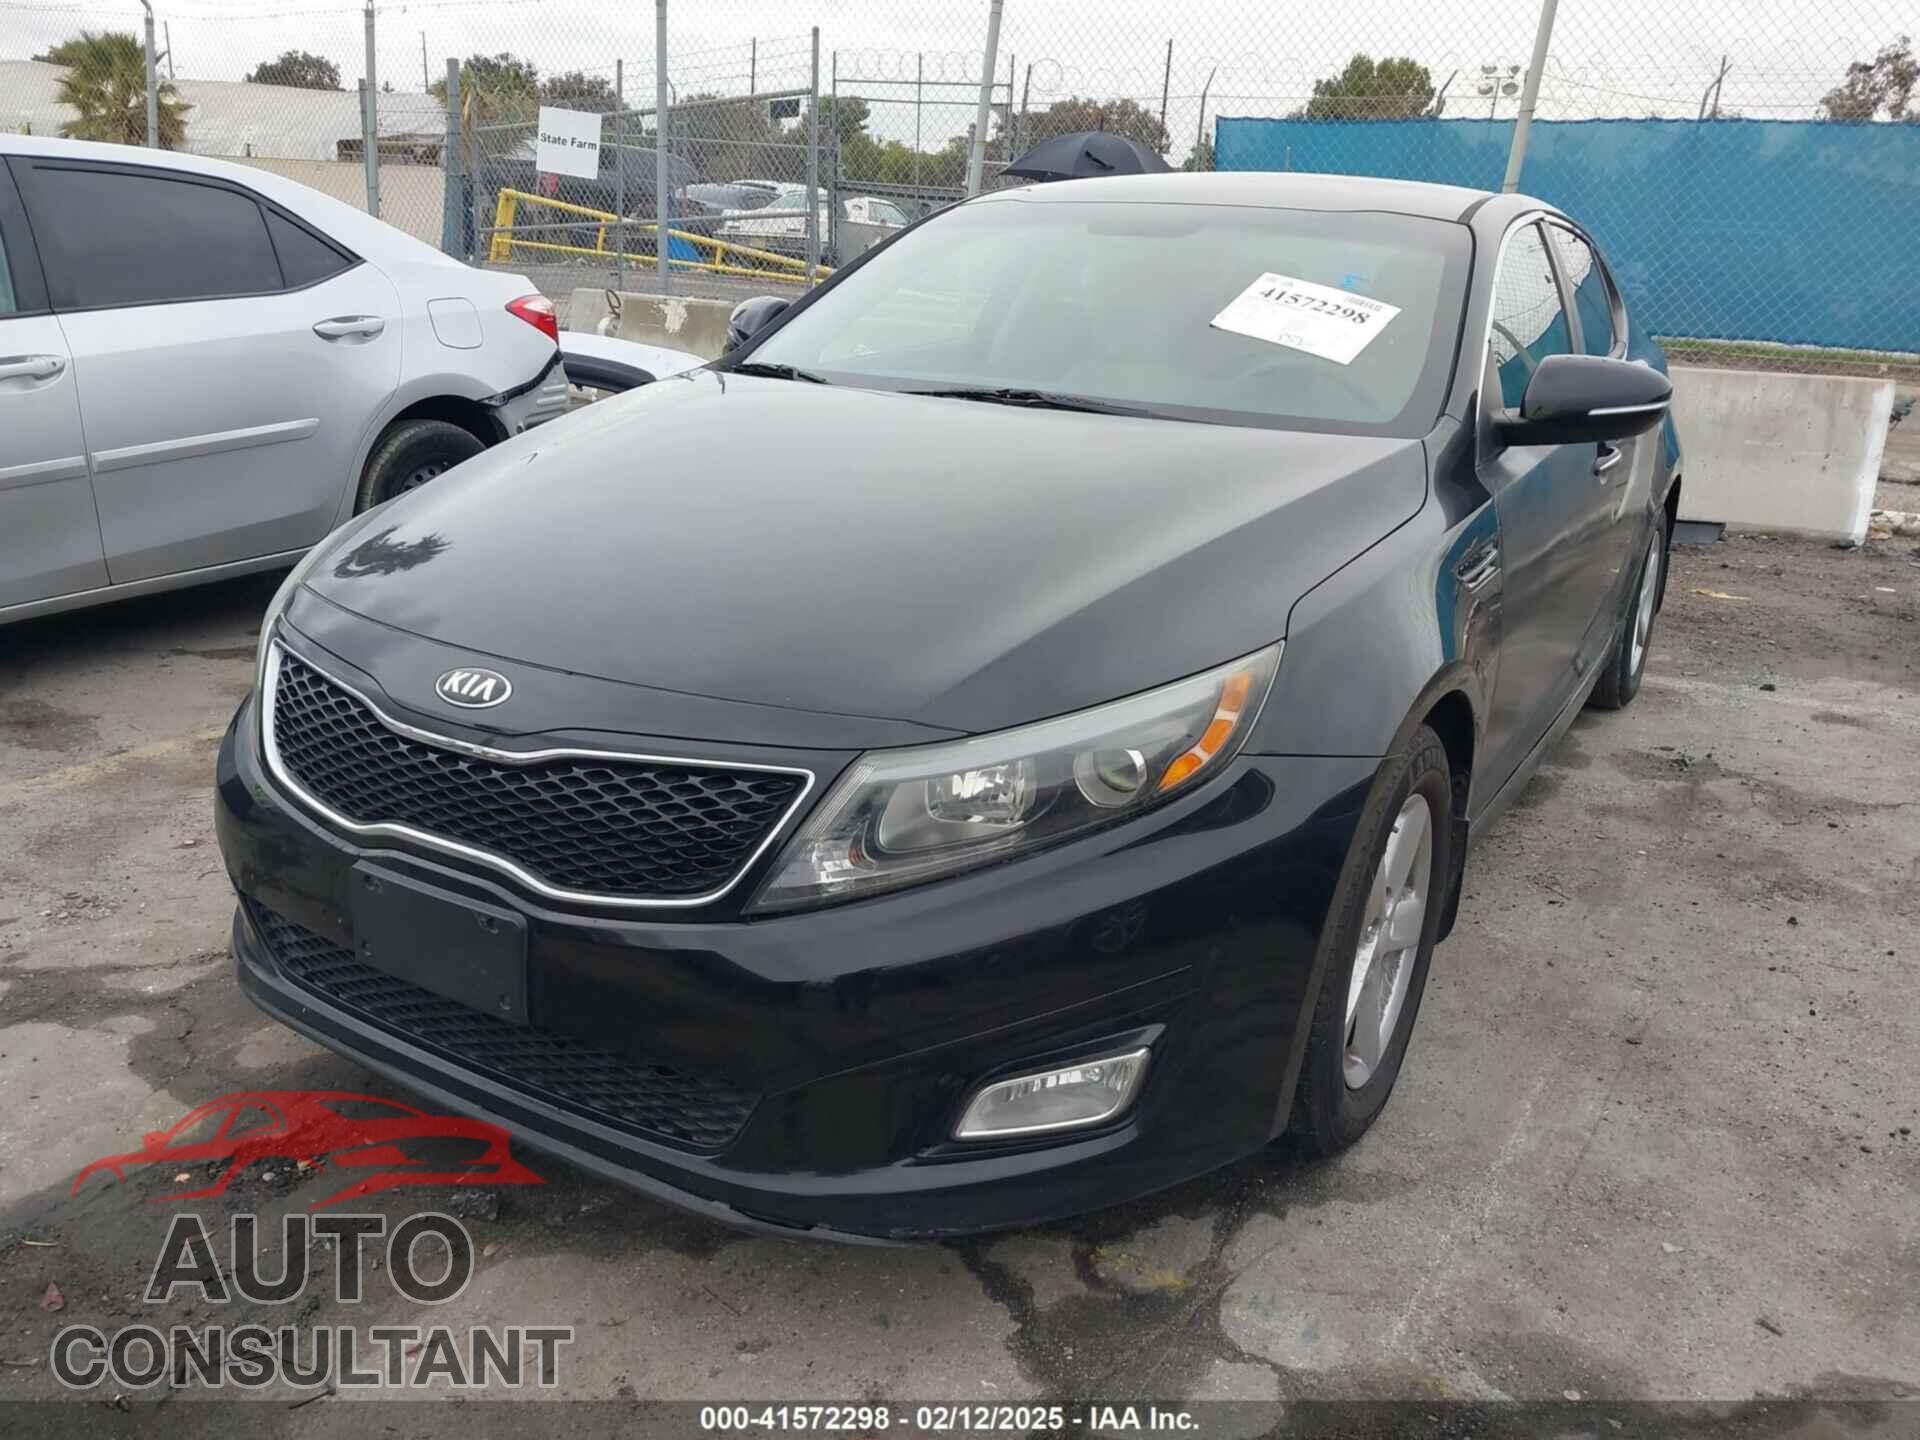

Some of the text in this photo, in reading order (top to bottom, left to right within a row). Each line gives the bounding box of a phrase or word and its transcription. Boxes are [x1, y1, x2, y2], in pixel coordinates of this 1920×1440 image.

[540, 132, 598, 151] State Farm
[1258, 287, 1372, 325] 41572298
[442, 670, 497, 701] KIA
